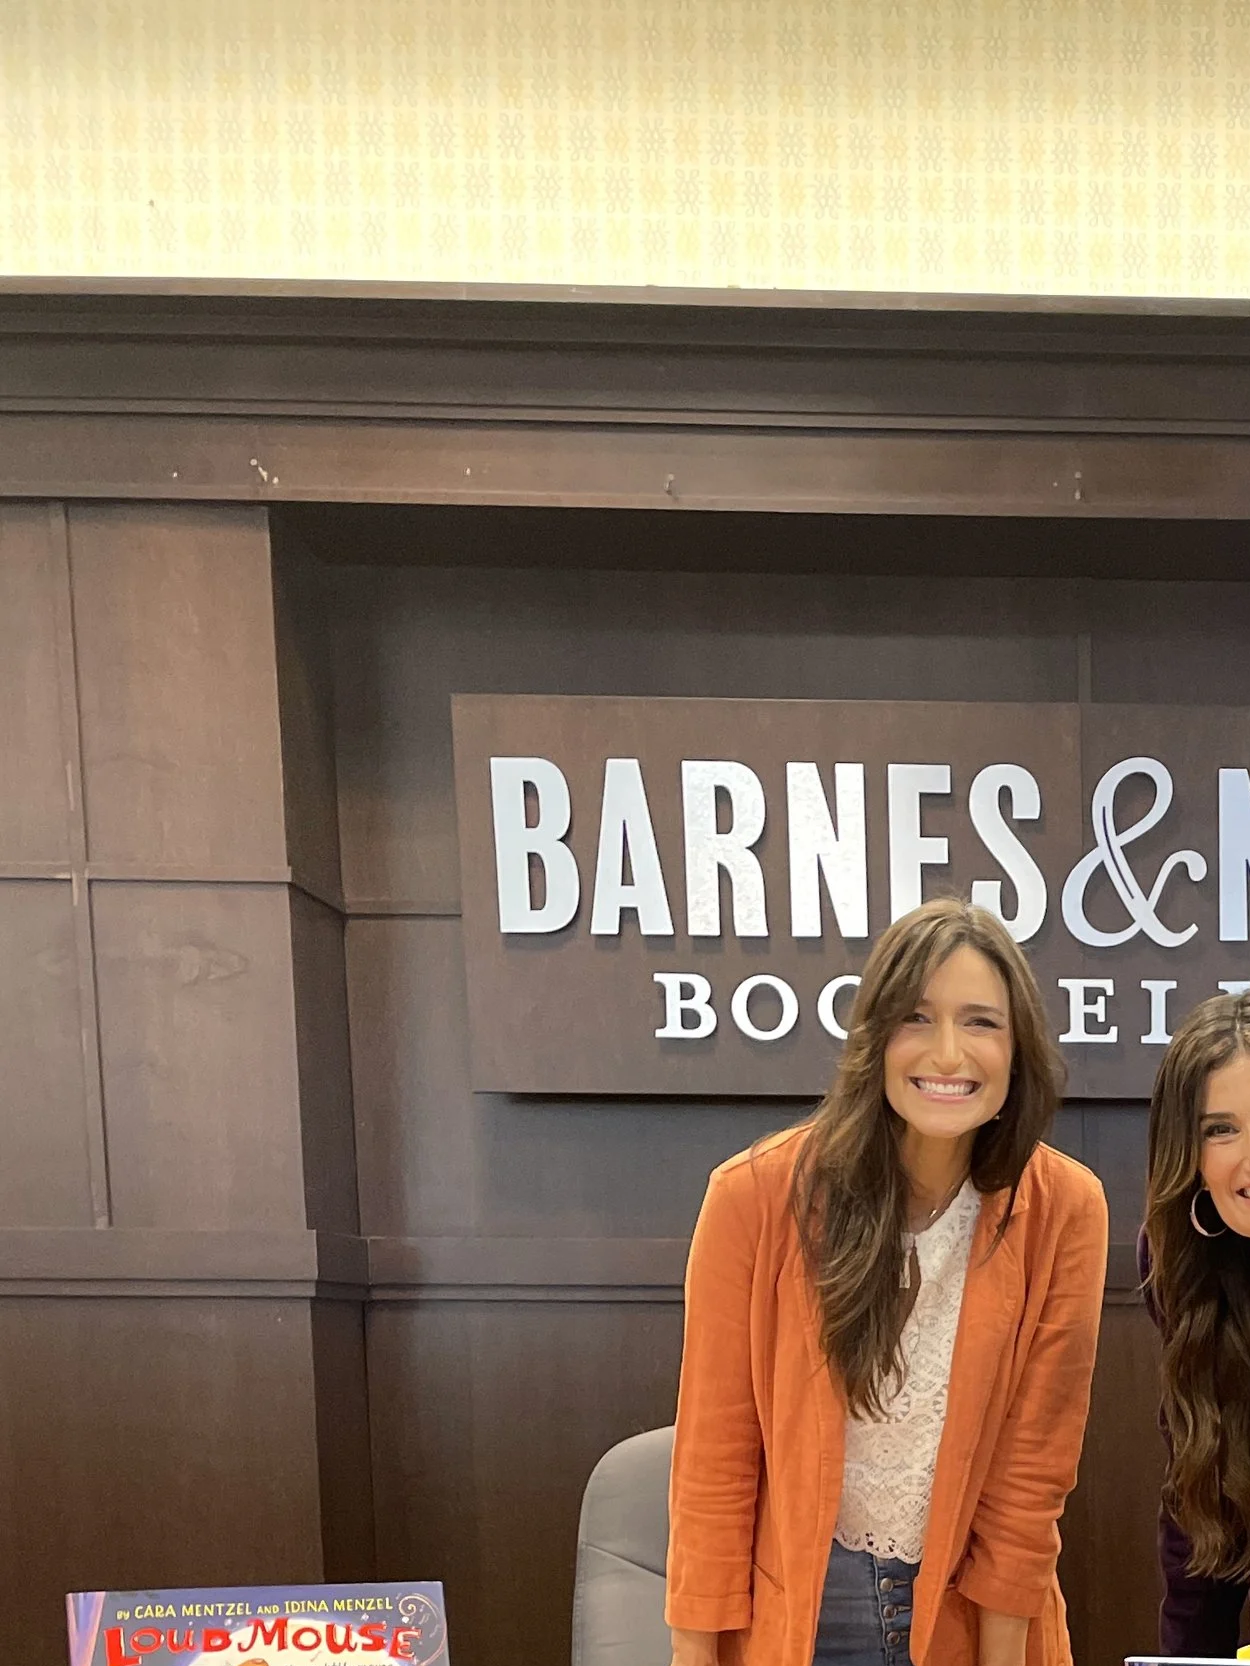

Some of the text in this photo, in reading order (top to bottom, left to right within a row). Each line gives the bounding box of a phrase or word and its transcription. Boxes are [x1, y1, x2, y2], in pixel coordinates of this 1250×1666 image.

[490, 757, 1047, 943] BARNES
[134, 1604, 176, 1618] CARA
[181, 1602, 252, 1617] MENTZEL
[257, 1605, 280, 1615] AND
[285, 1600, 328, 1614] IDINA
[333, 1597, 393, 1611] MENZEL
